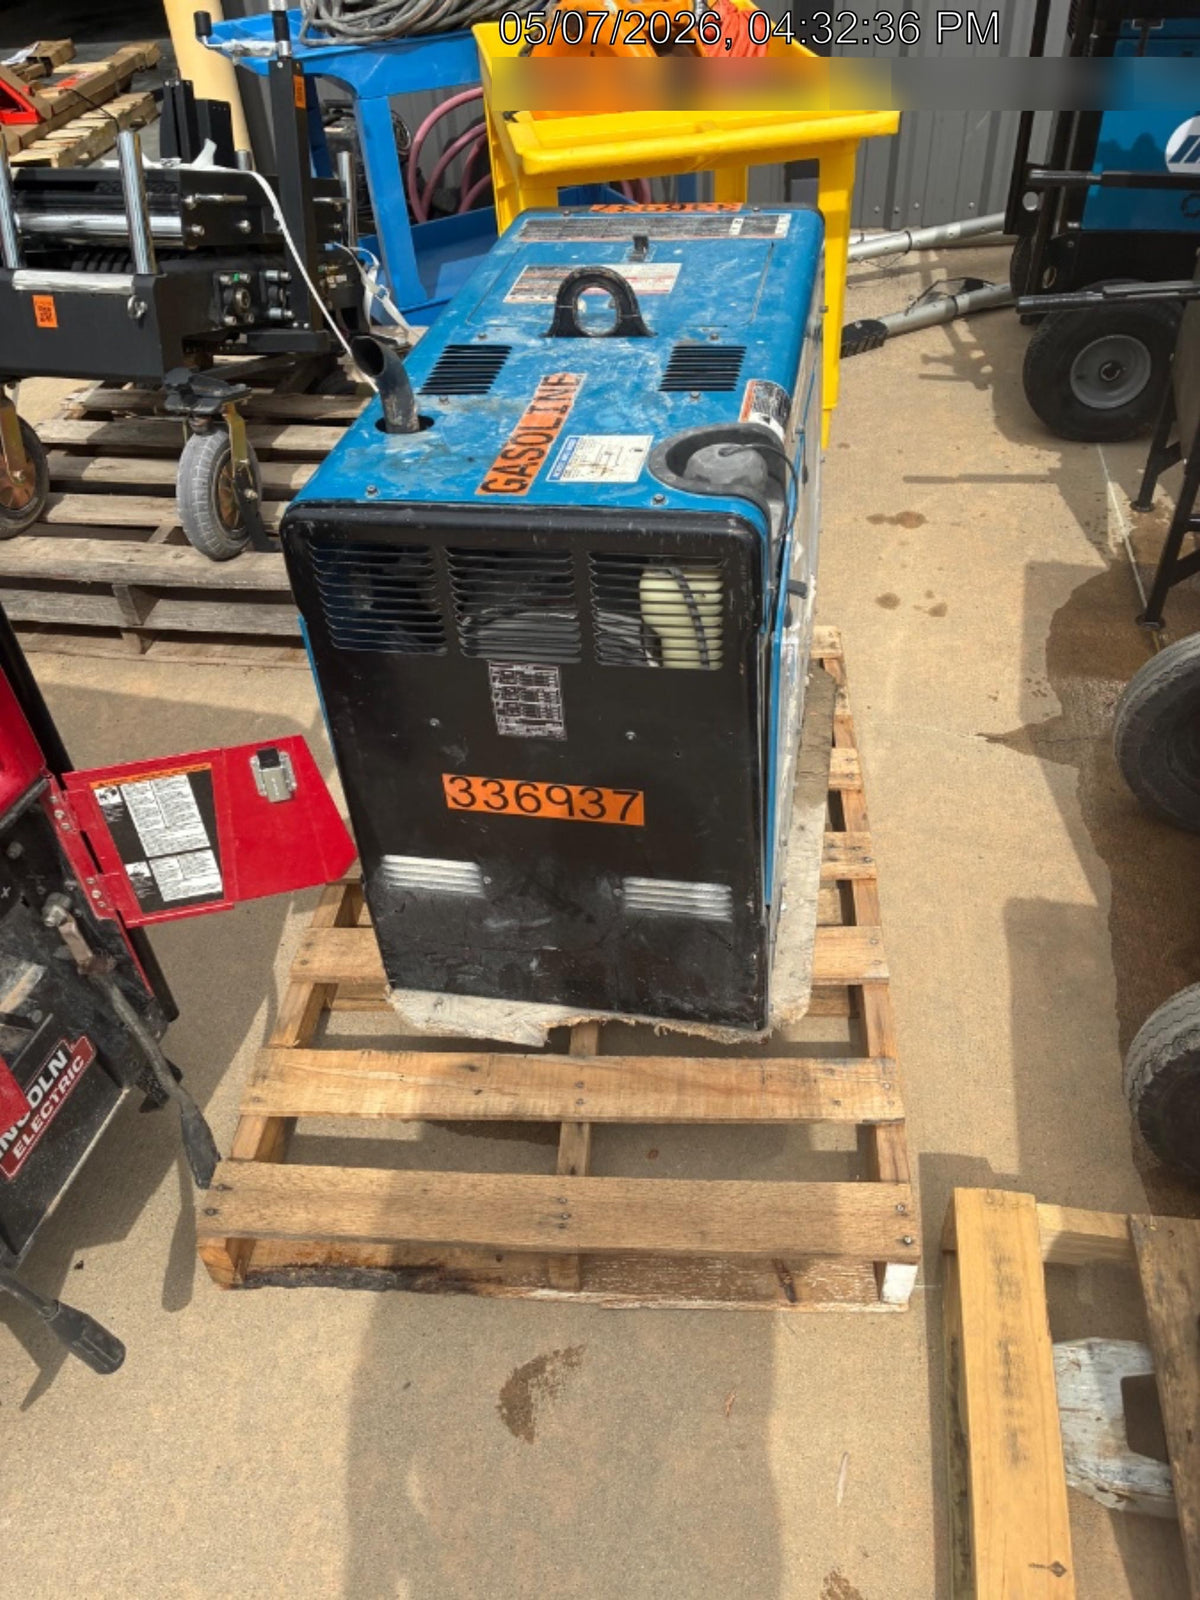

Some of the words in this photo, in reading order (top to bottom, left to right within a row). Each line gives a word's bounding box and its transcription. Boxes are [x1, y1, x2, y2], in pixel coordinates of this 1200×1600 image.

[480, 373, 581, 493] GASOLINE
[449, 776, 640, 822] 336937
[13, 1055, 85, 1160] ELECTRIC
